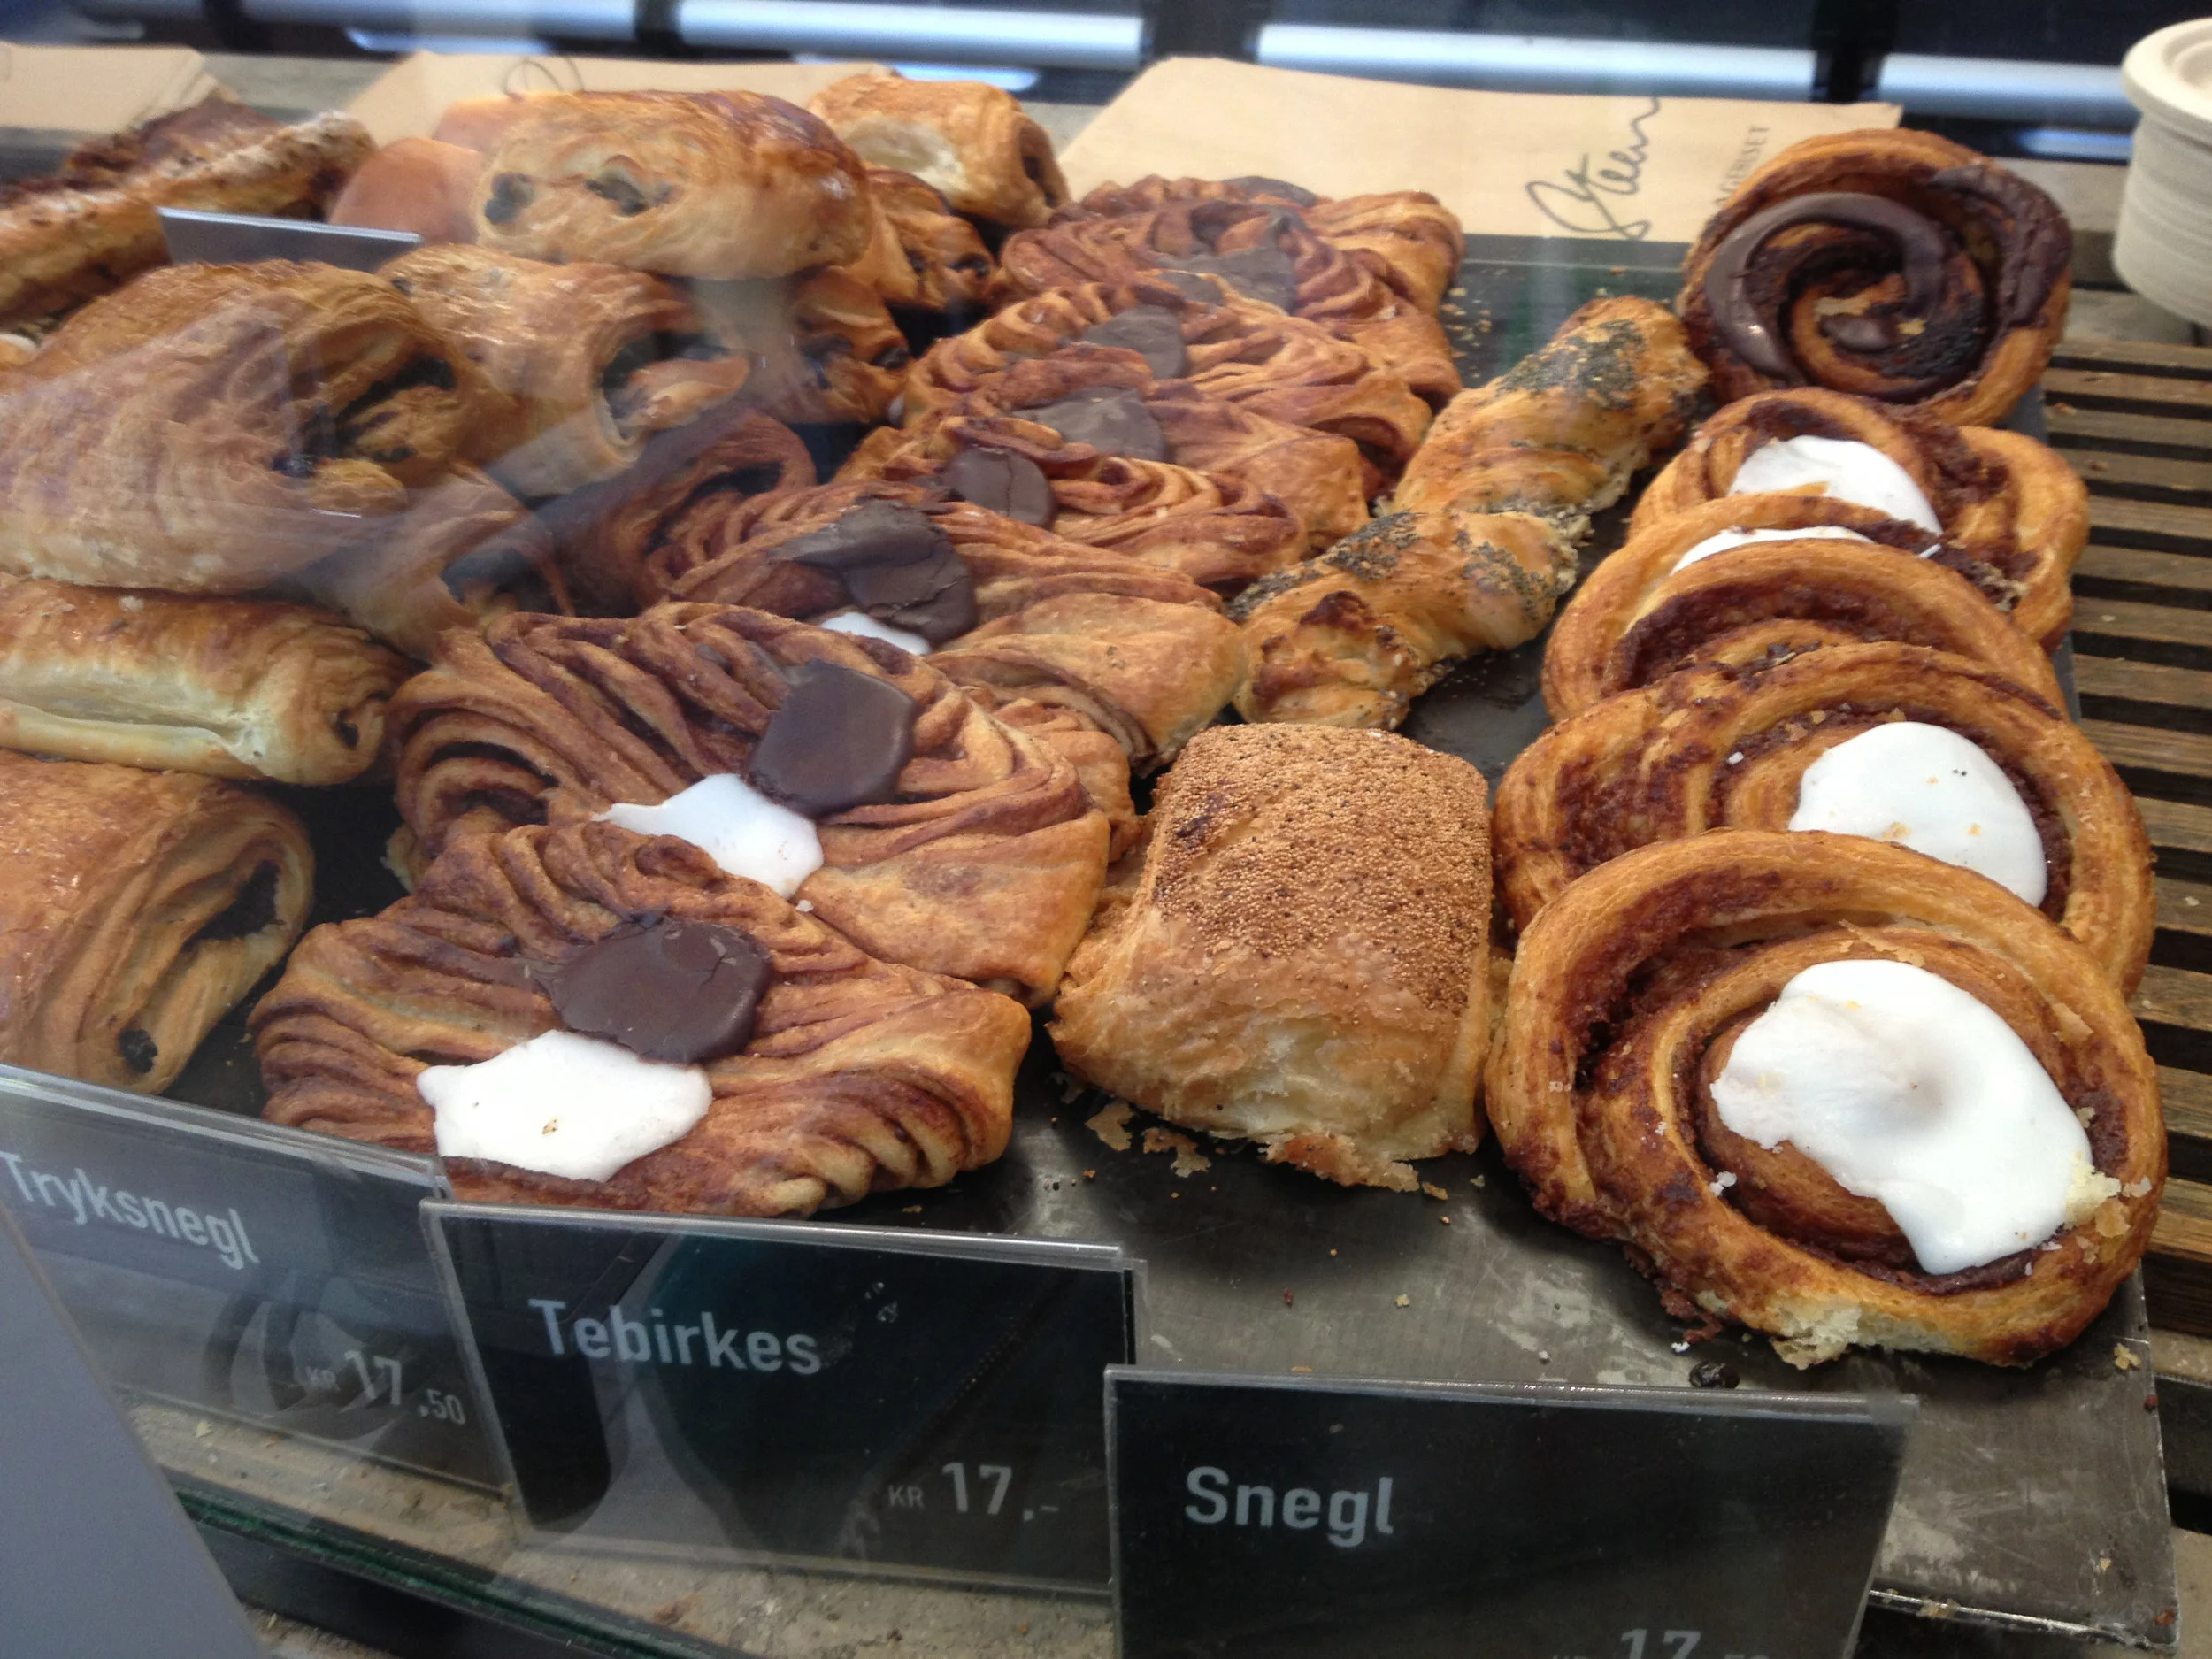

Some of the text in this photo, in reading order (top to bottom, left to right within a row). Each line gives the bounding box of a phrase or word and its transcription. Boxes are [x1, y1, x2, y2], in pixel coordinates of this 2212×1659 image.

[0, 1151, 260, 1270] Tryksnegl
[527, 1298, 821, 1375] Tebirkes
[888, 1484, 925, 1509] KR
[1185, 1465, 1394, 1548] Snegl
